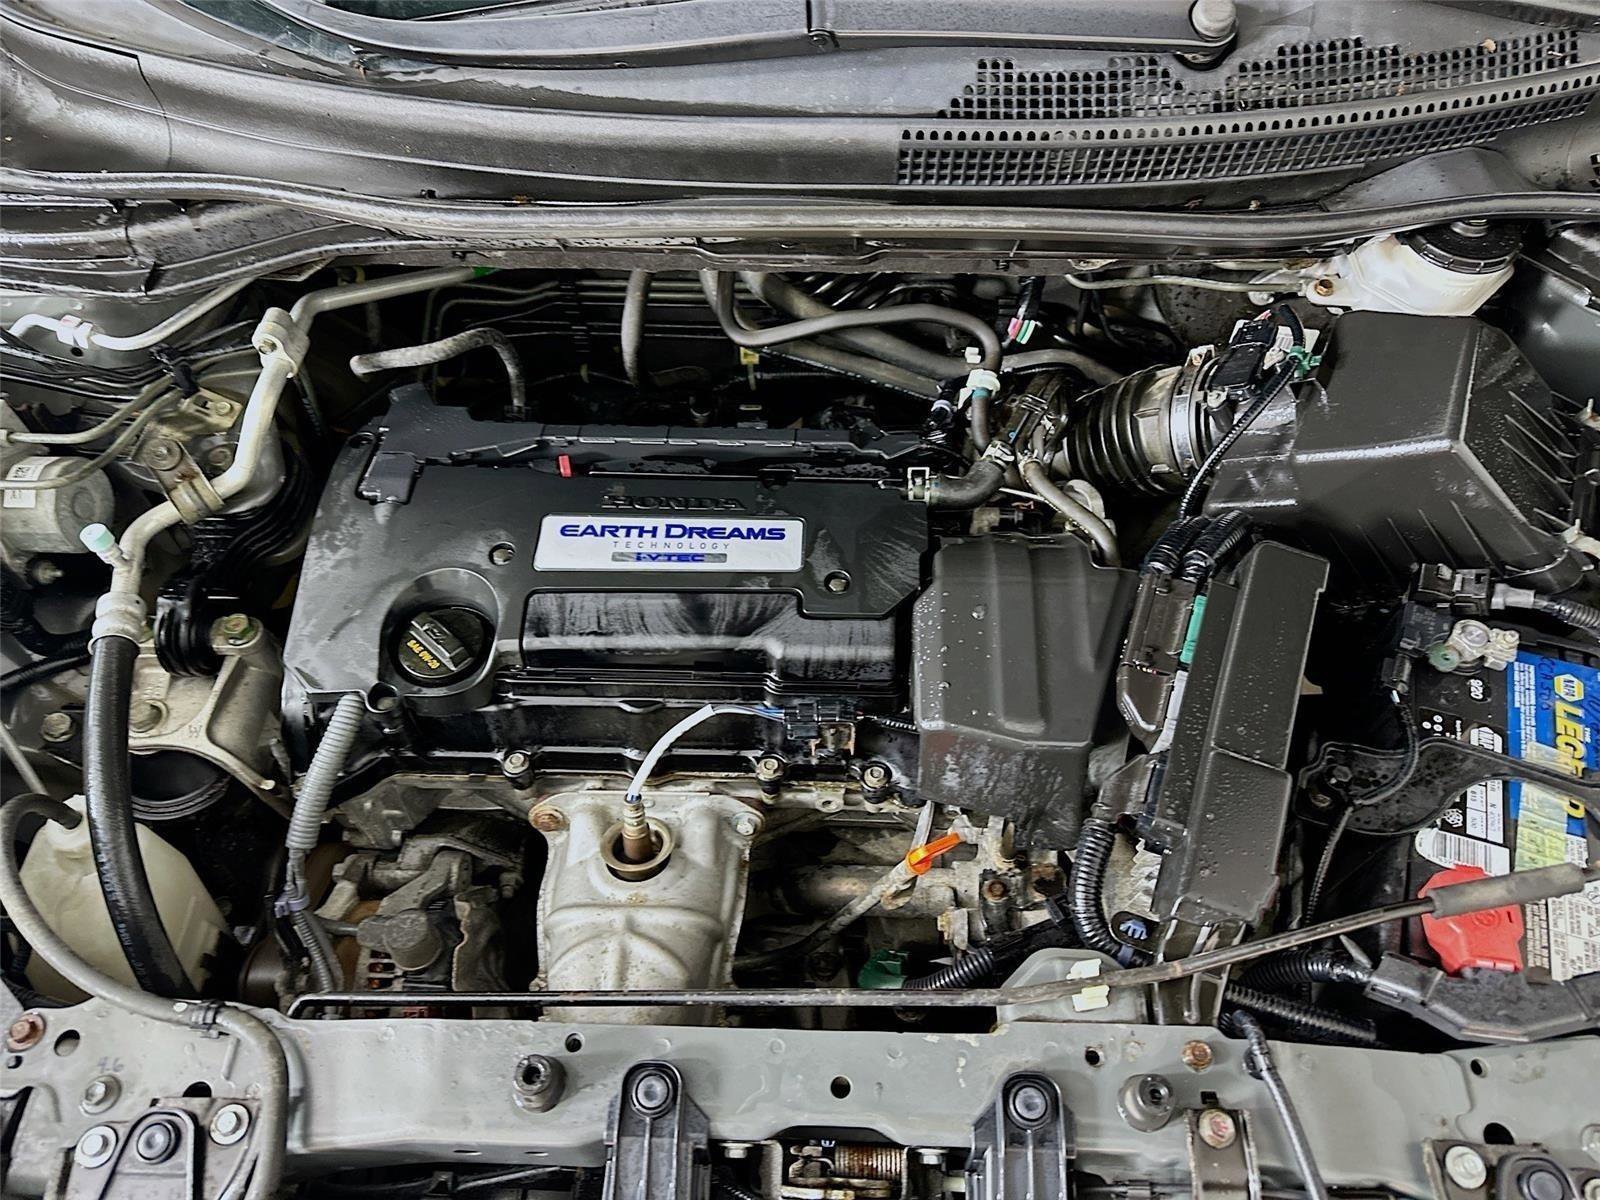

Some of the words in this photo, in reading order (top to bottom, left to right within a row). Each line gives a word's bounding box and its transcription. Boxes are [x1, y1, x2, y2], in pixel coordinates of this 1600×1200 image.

[601, 495, 747, 510] HONDA
[559, 524, 658, 539] EARTH
[664, 523, 787, 541] DREAMS
[613, 541, 731, 550] TECHNOLOGY
[1562, 679, 1576, 698] NAPA
